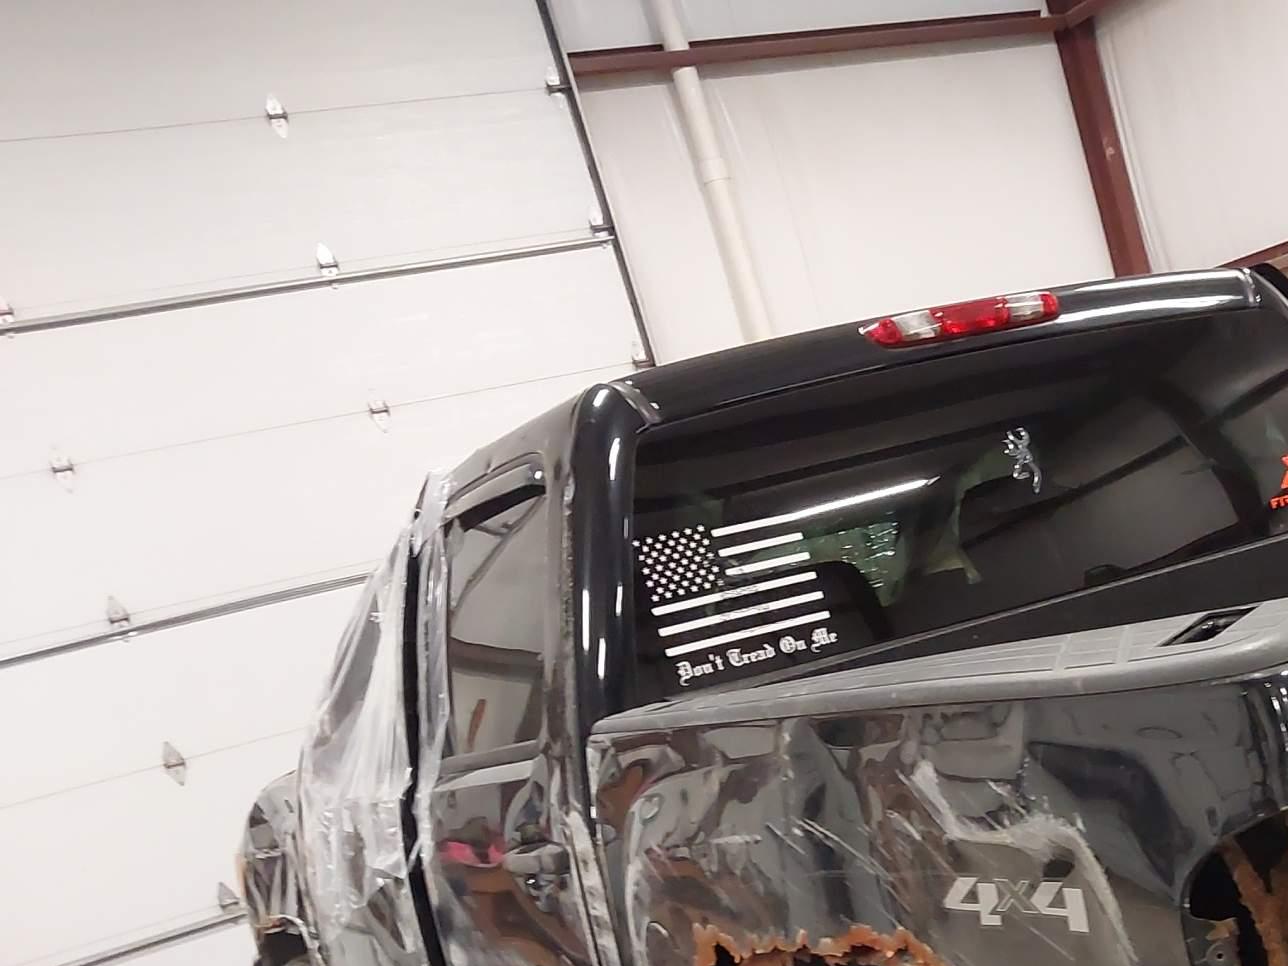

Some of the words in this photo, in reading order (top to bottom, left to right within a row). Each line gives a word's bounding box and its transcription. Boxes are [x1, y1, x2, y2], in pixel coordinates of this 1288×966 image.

[675, 654, 725, 686] Don't
[726, 643, 777, 667] Tread
[779, 635, 808, 654] On
[810, 627, 839, 653] Me
